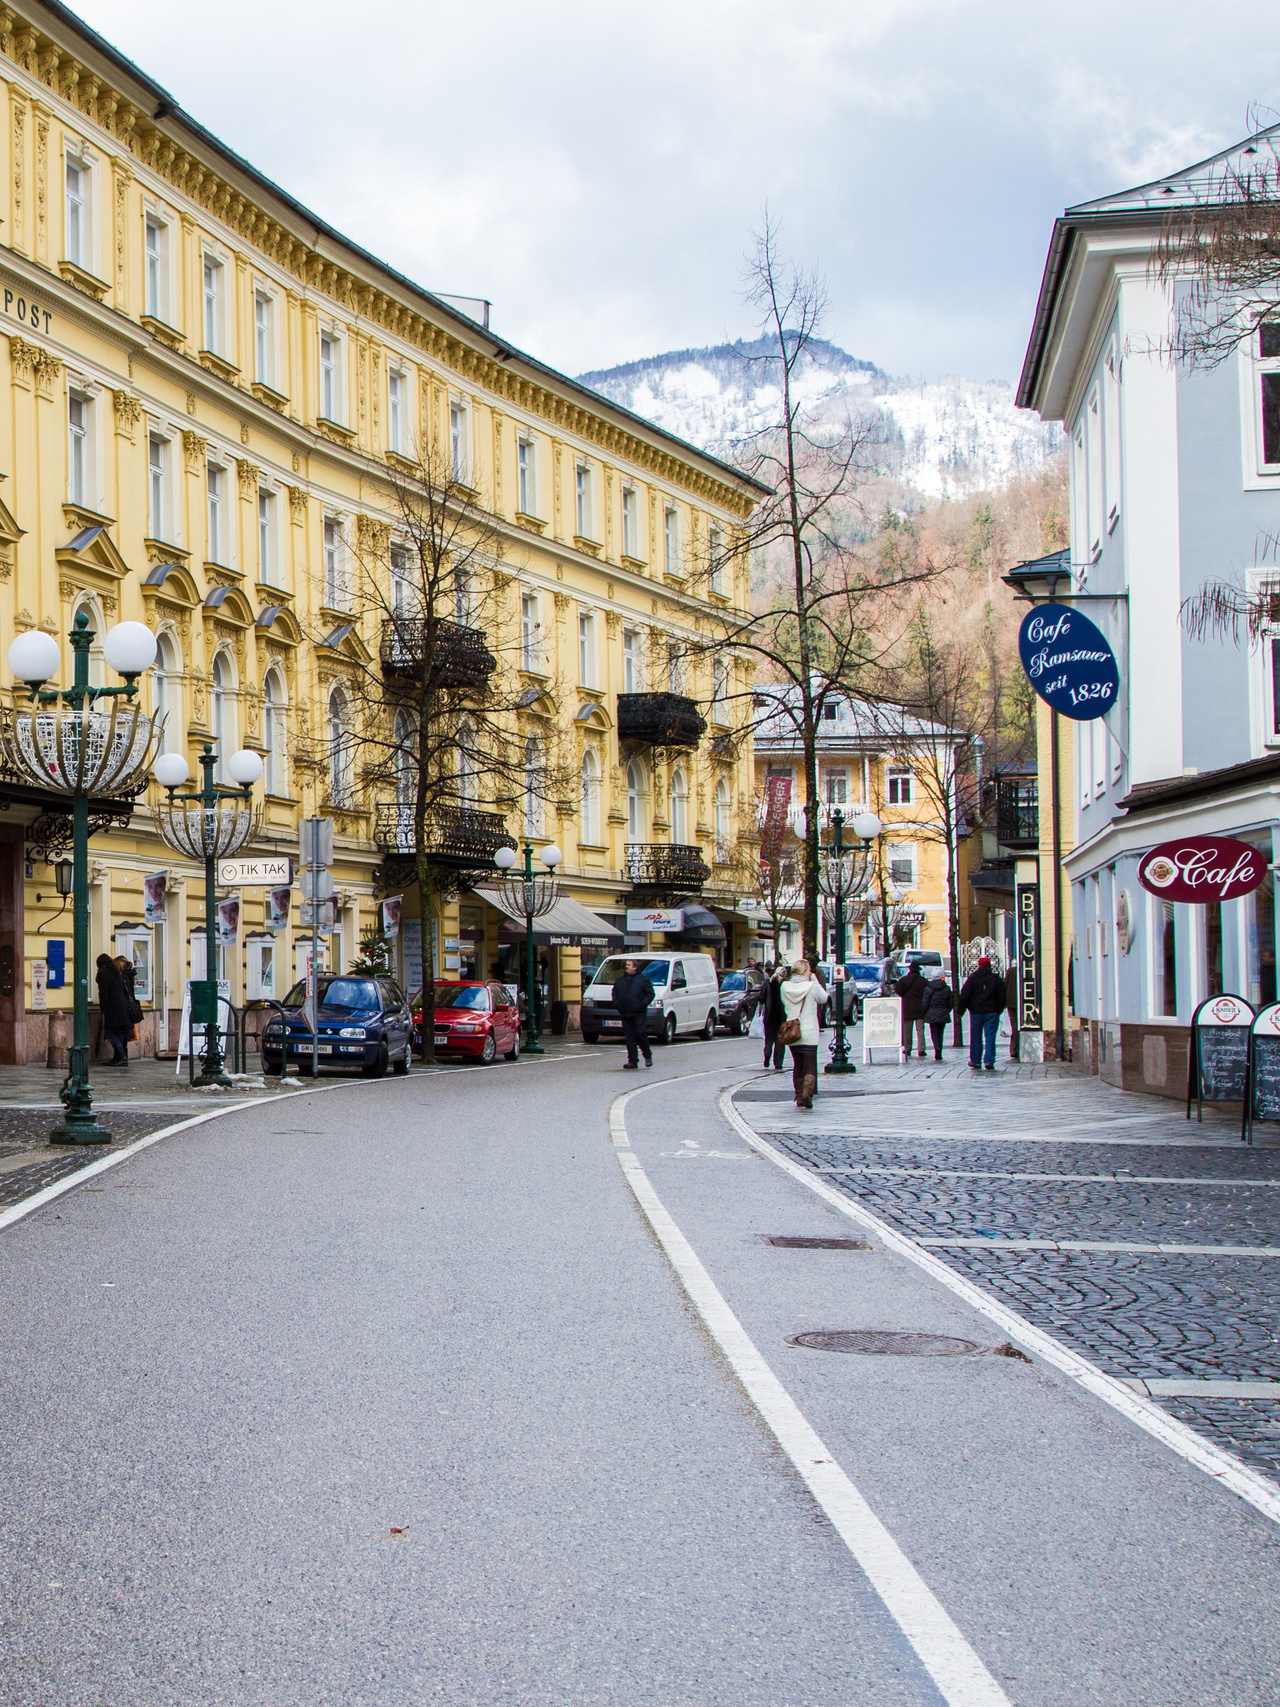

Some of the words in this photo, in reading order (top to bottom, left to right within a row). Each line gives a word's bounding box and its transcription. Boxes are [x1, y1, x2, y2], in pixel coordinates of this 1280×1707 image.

[4, 288, 53, 334] POST
[1027, 612, 1071, 643] Cafe
[1029, 647, 1111, 678] Ramsauer
[1045, 675, 1067, 694] seit
[1069, 682, 1113, 706] 1826
[239, 864, 258, 875] TIK
[262, 863, 286, 874] TAK
[1174, 848, 1255, 896] Cafe
[1022, 893, 1035, 1021] BÜCHER
